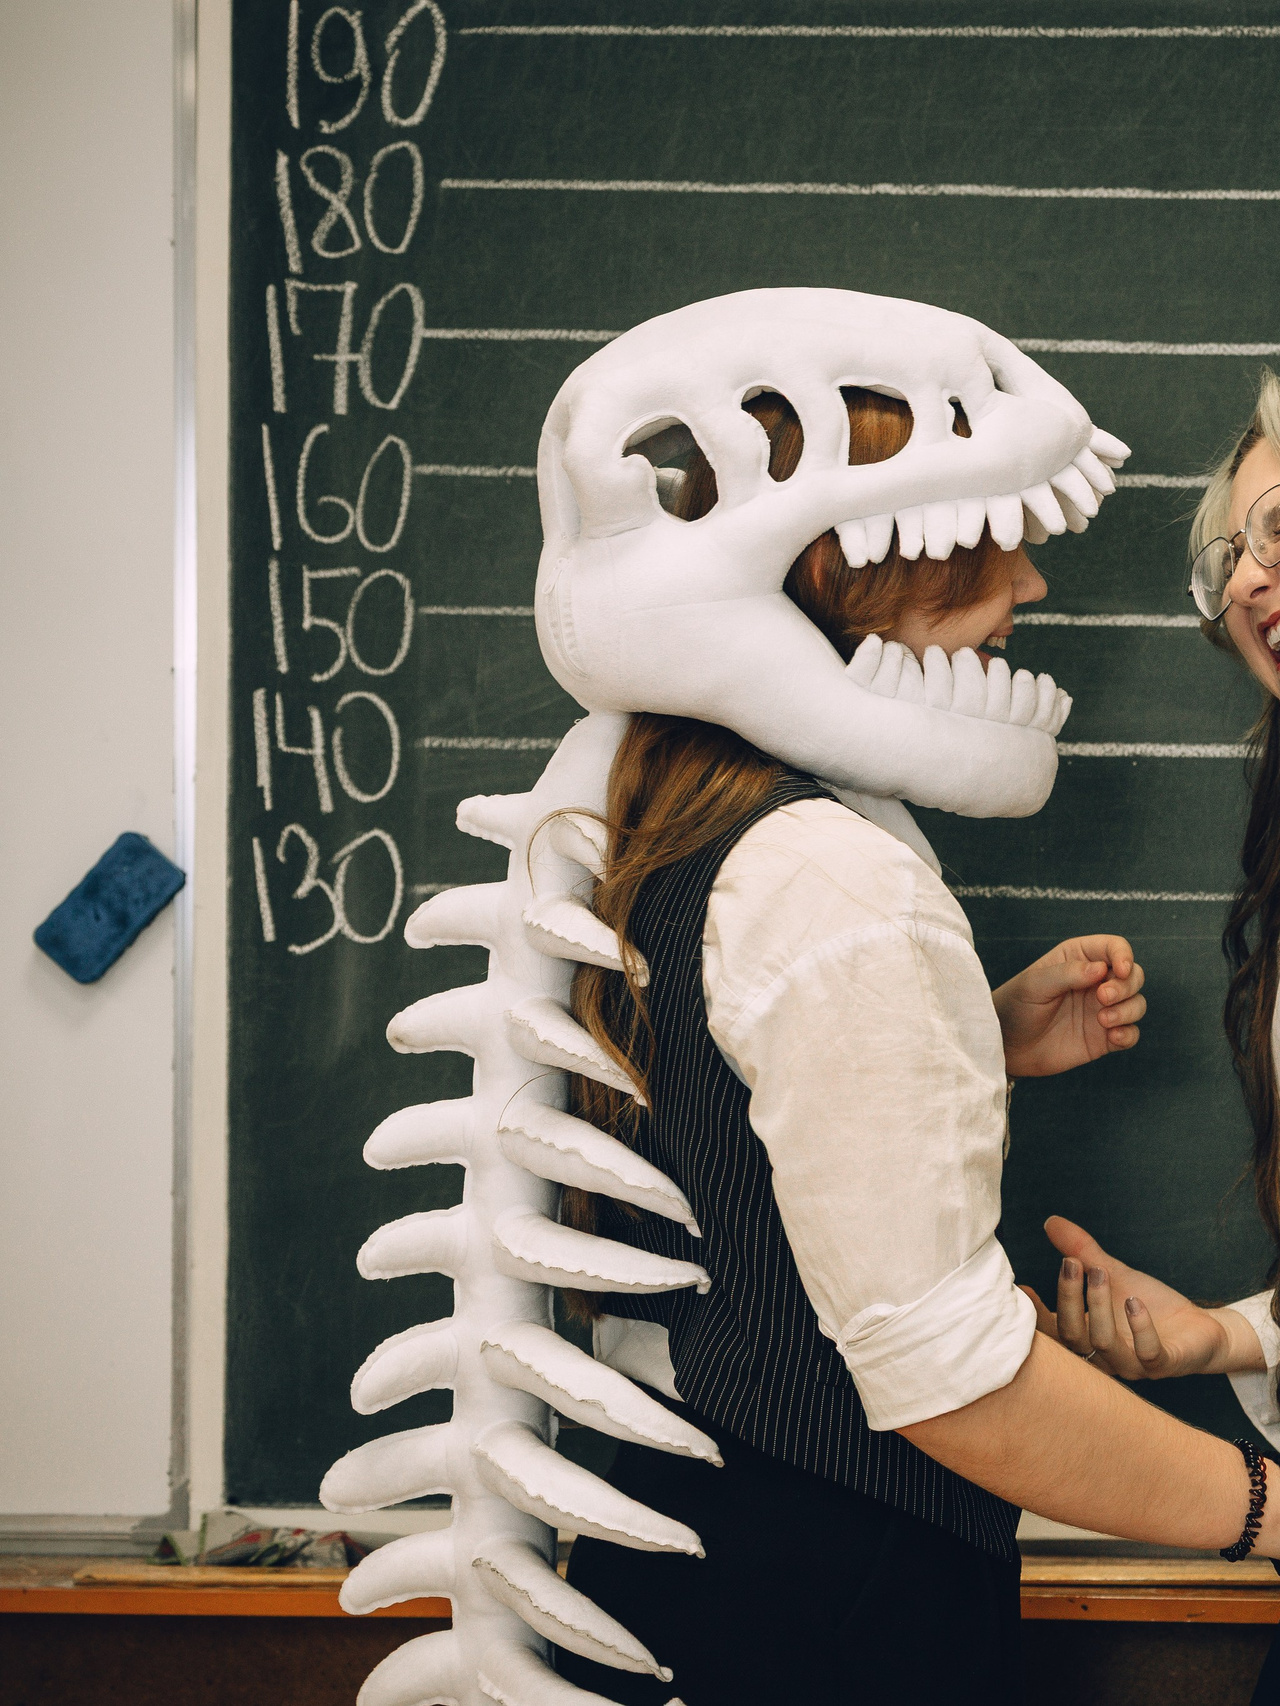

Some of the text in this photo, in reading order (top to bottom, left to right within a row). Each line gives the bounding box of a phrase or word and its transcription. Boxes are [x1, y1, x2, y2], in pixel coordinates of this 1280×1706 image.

[286, 0, 447, 133] 190
[276, 141, 424, 273] 180
[266, 278, 424, 414] 170
[262, 423, 412, 553] 160
[269, 558, 414, 682] 150
[253, 688, 401, 813] 140
[252, 823, 403, 954] 130
